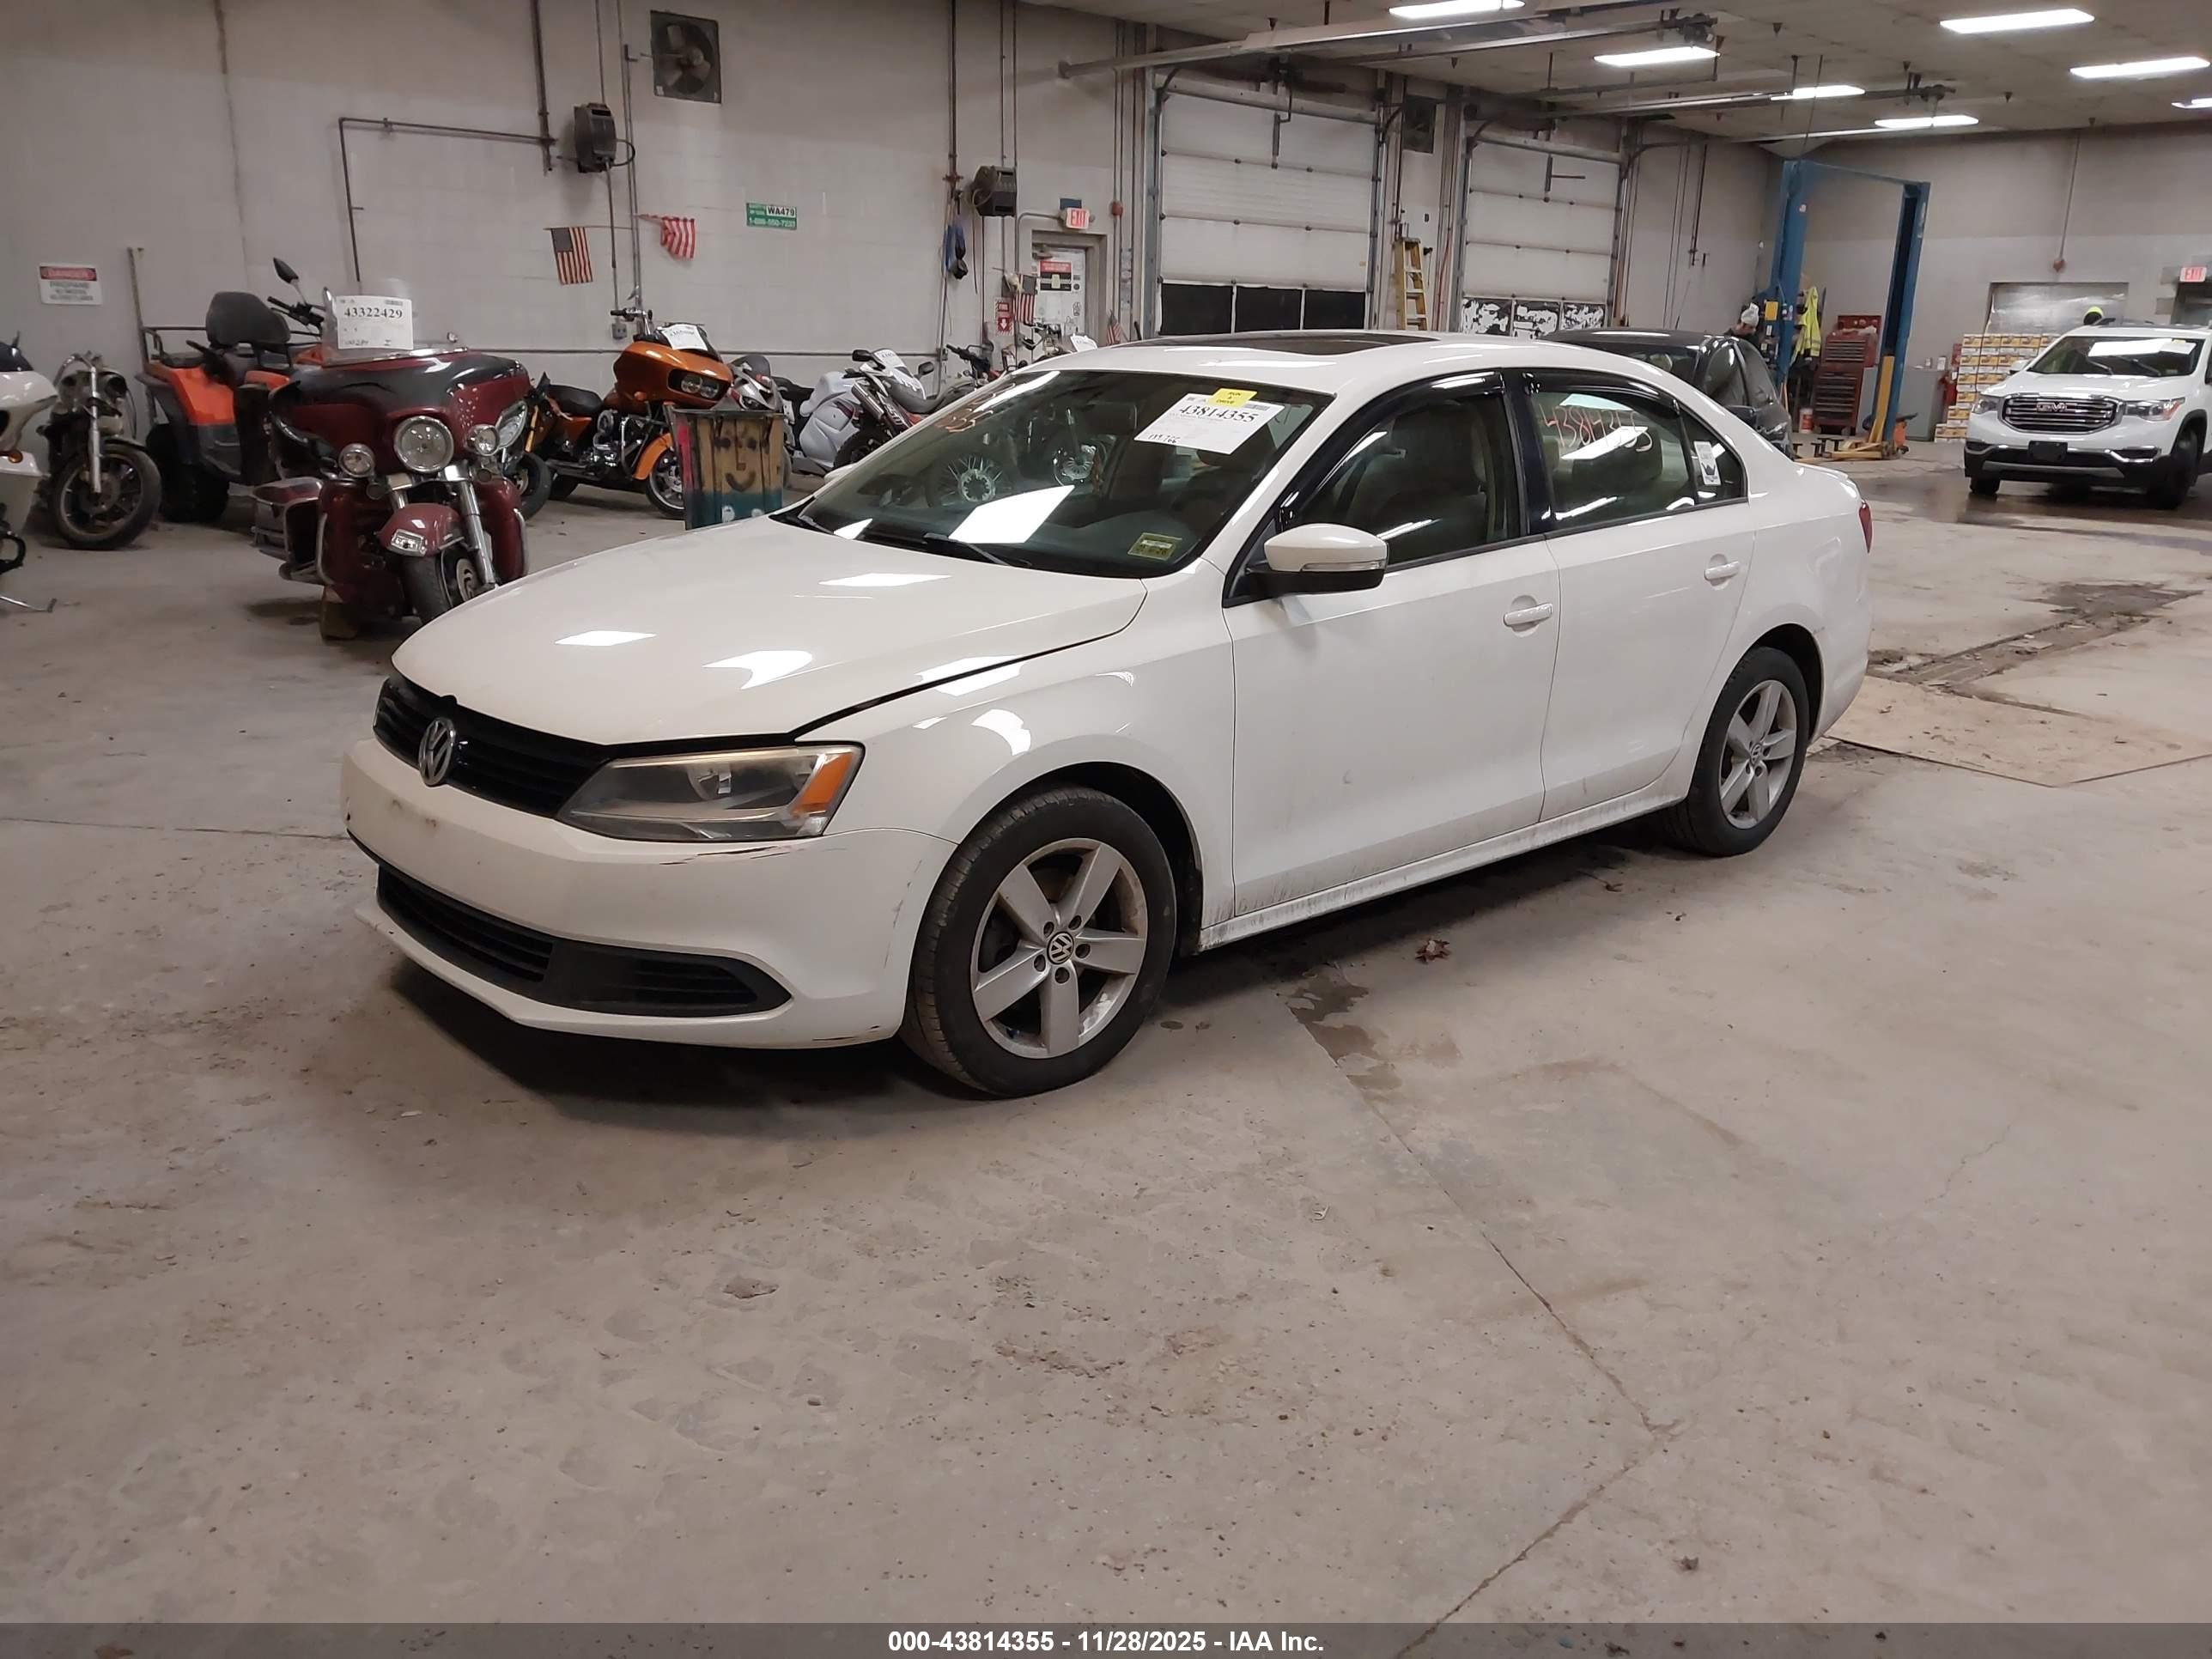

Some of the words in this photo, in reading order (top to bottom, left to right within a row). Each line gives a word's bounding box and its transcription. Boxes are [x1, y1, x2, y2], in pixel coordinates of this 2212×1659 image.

[768, 207, 795, 216] WA479
[1071, 210, 1086, 227] EXIT
[344, 307, 403, 319] 43322429
[1179, 404, 1260, 422] 43814355
